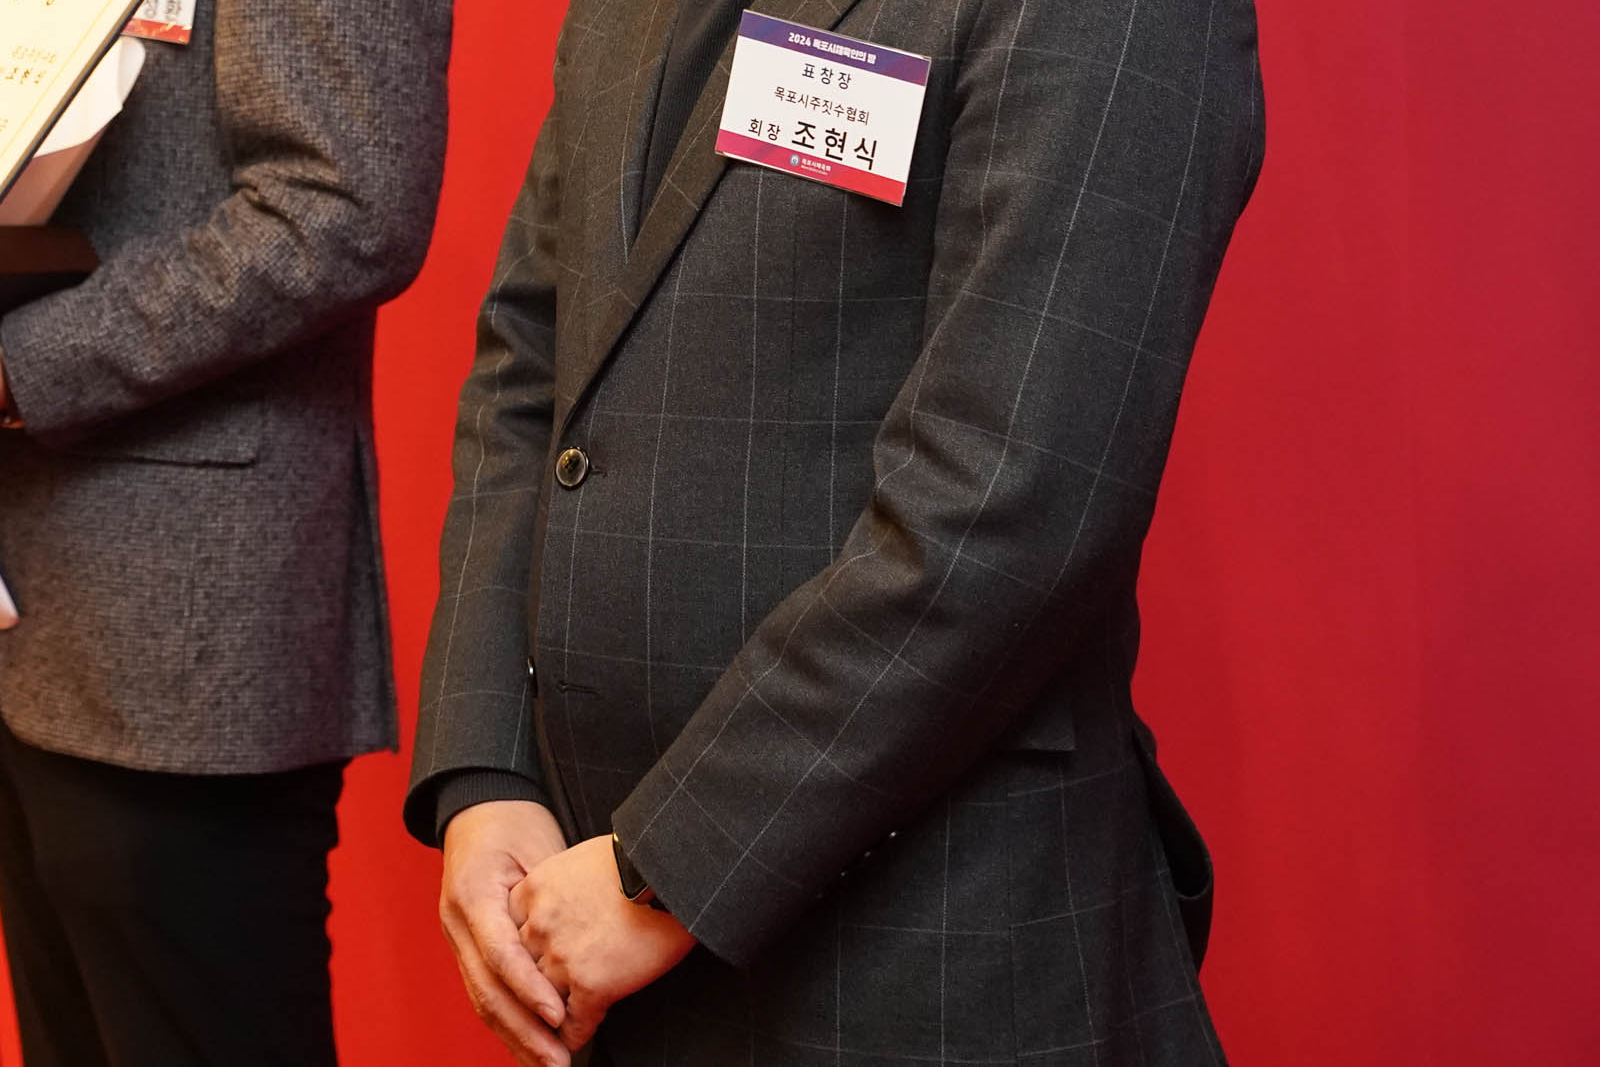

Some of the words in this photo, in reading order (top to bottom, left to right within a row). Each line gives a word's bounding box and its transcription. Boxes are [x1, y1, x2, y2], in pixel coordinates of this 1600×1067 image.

[787, 32, 812, 47] 2024
[801, 62, 853, 91] 표창장
[773, 85, 871, 126] 목포시주짓수협회
[747, 117, 782, 142] 회장
[790, 120, 879, 171] 조현식
